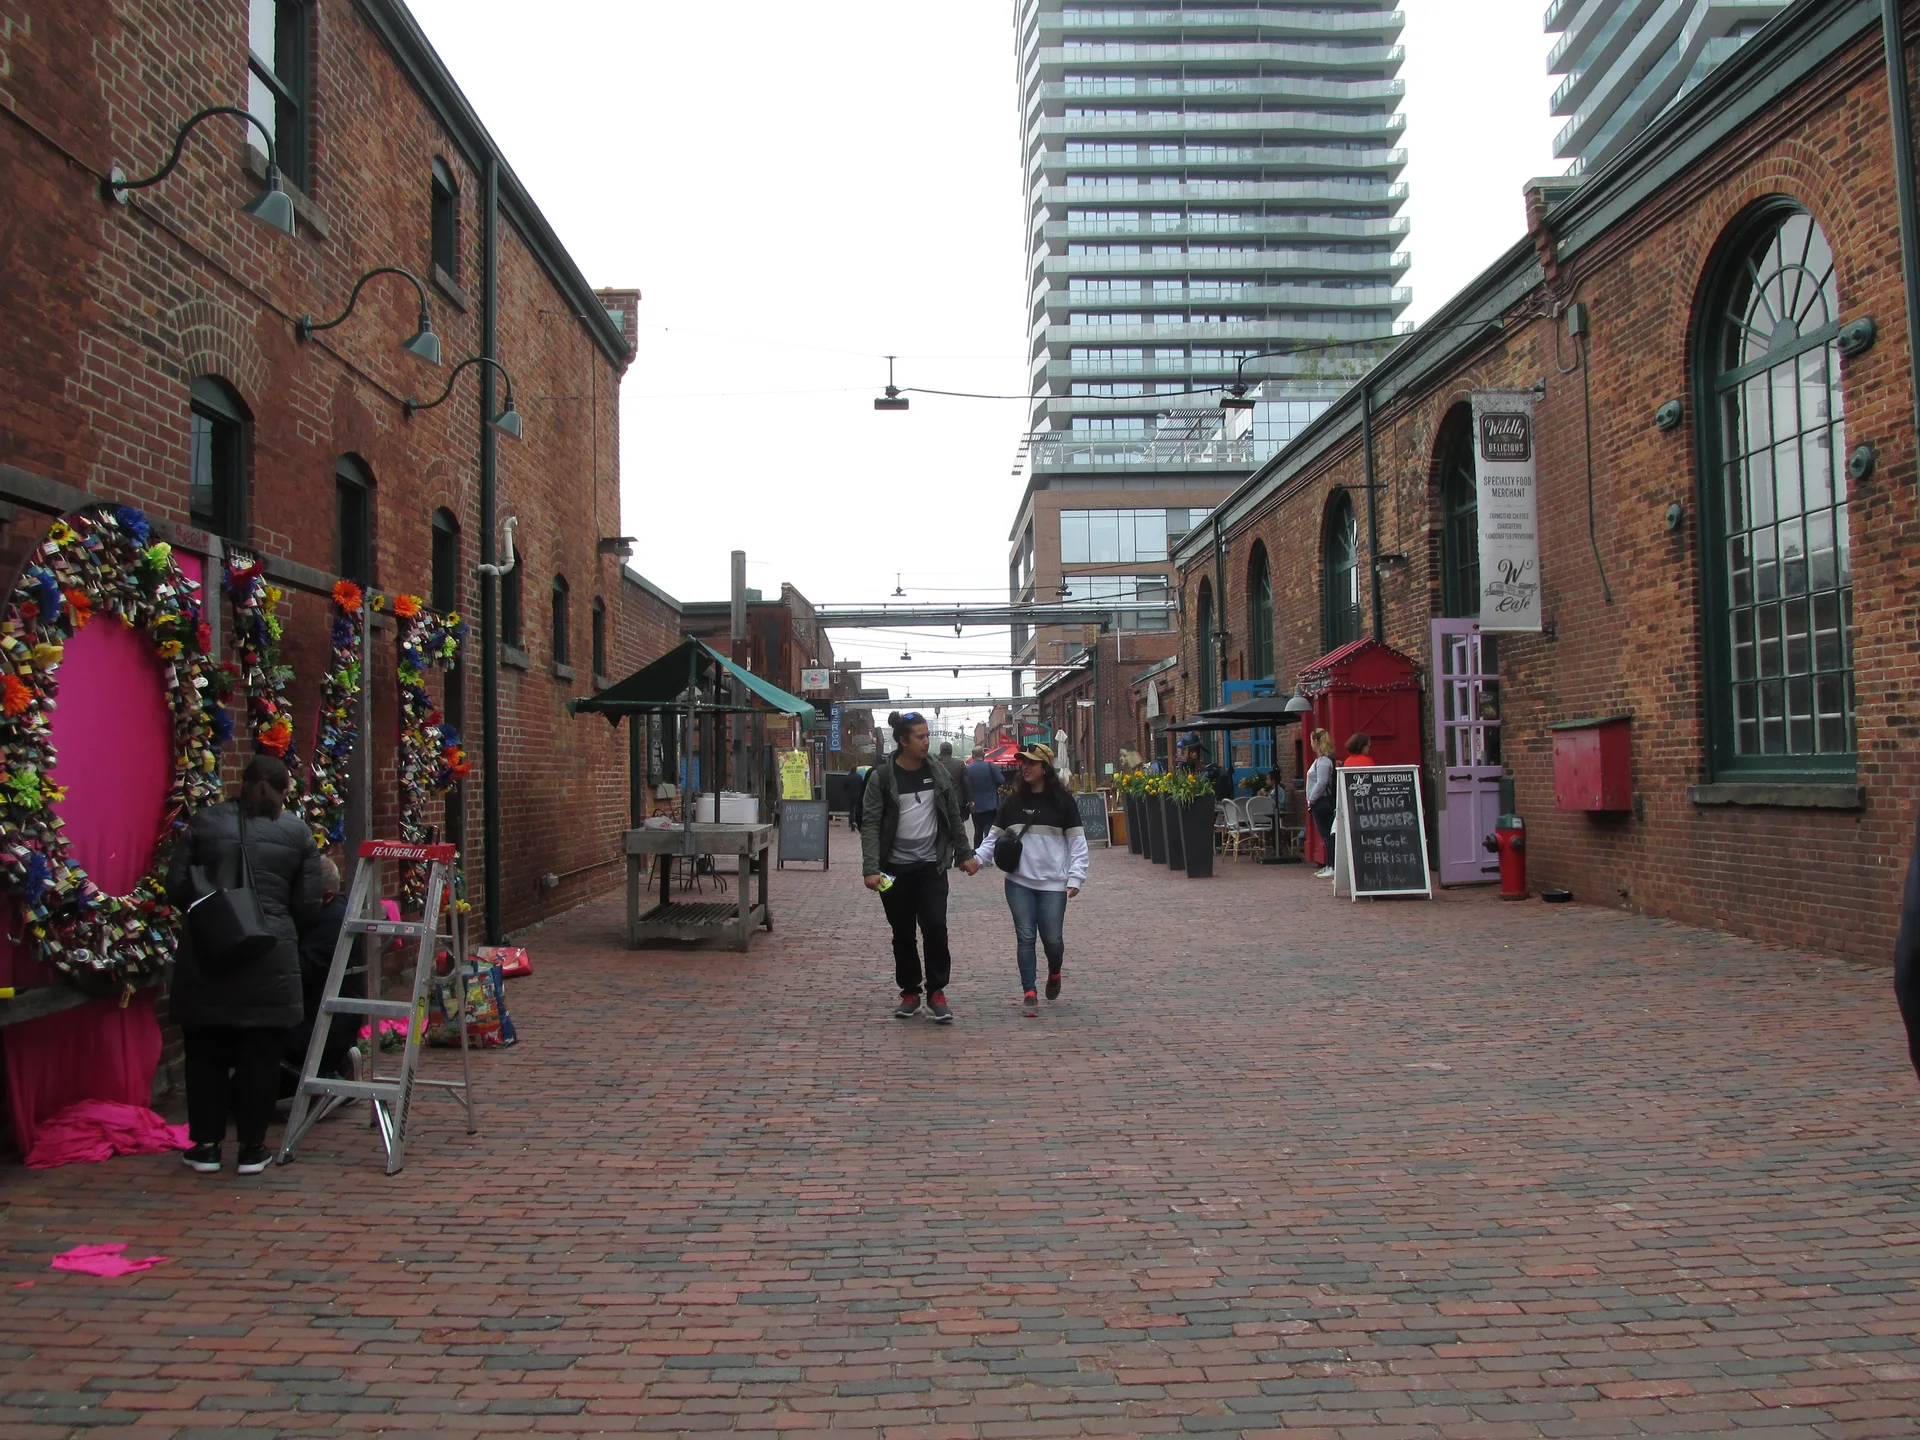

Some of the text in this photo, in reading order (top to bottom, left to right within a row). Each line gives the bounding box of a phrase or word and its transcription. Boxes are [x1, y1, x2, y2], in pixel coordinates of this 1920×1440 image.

[1484, 418, 1525, 439] Wildly
[1488, 443, 1524, 453] DELICIOUS
[1483, 476, 1532, 486] SPECIALTY FOOD
[1491, 487, 1525, 497] MERCHANT
[831, 708, 840, 747] BERGO
[1372, 774, 1412, 783] DAILY SPECIALS
[1359, 812, 1413, 829] BUSSER
[372, 846, 427, 858] FEATHERLITE
[1364, 851, 1417, 865] BARISTA
[399, 1065, 415, 1142] FEATHERLITE
